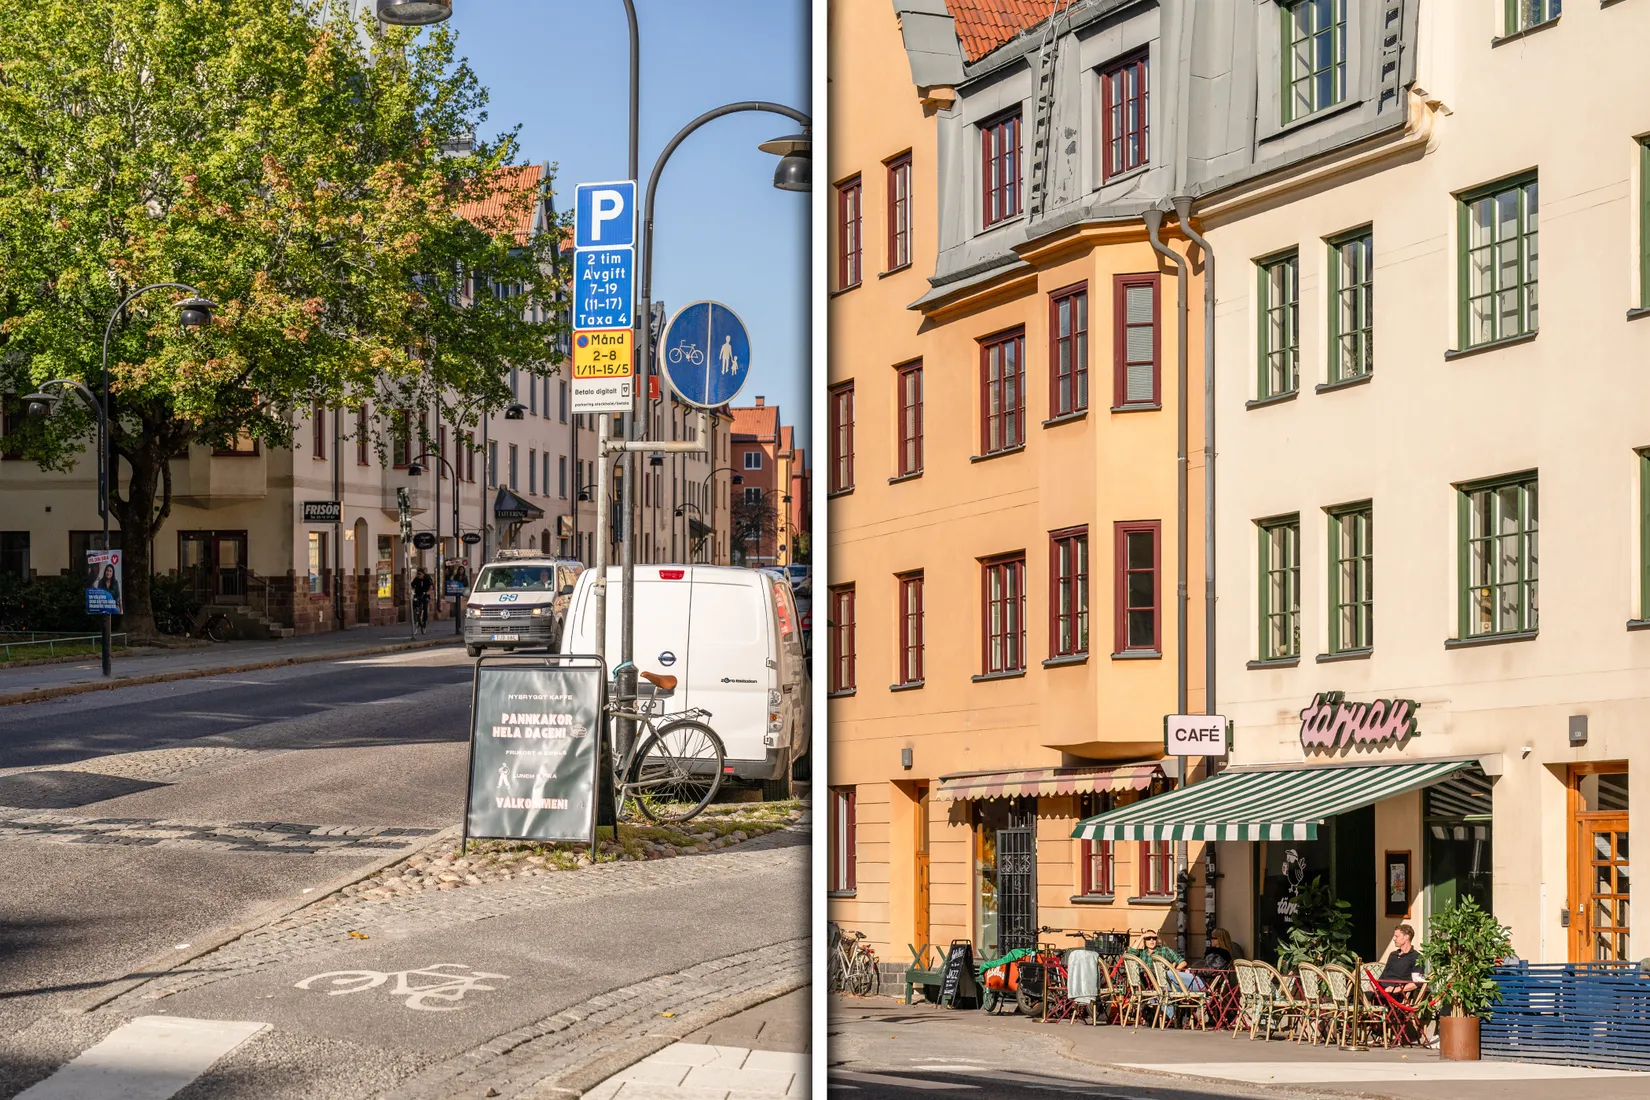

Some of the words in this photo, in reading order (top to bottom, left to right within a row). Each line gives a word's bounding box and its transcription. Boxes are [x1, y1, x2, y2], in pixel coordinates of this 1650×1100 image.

[591, 189, 624, 241] P
[587, 253, 596, 265] 2
[600, 252, 622, 265] tim
[583, 267, 626, 282] Avgift
[590, 283, 618, 295] 7-19
[584, 296, 623, 311] (11-17)
[579, 313, 613, 325] Taxa
[618, 312, 627, 324] 4
[591, 333, 624, 345] Månd
[593, 350, 617, 361] 2-8
[576, 363, 629, 375] 1/11-15/5
[575, 388, 595, 396] Betala
[596, 387, 618, 396] digitalt
[305, 502, 340, 515] FRISÖR
[501, 712, 573, 725] PANNKAKOR
[492, 726, 522, 738] HELA
[524, 727, 567, 739] DAGEN!
[1175, 725, 1220, 742] CAFÉ
